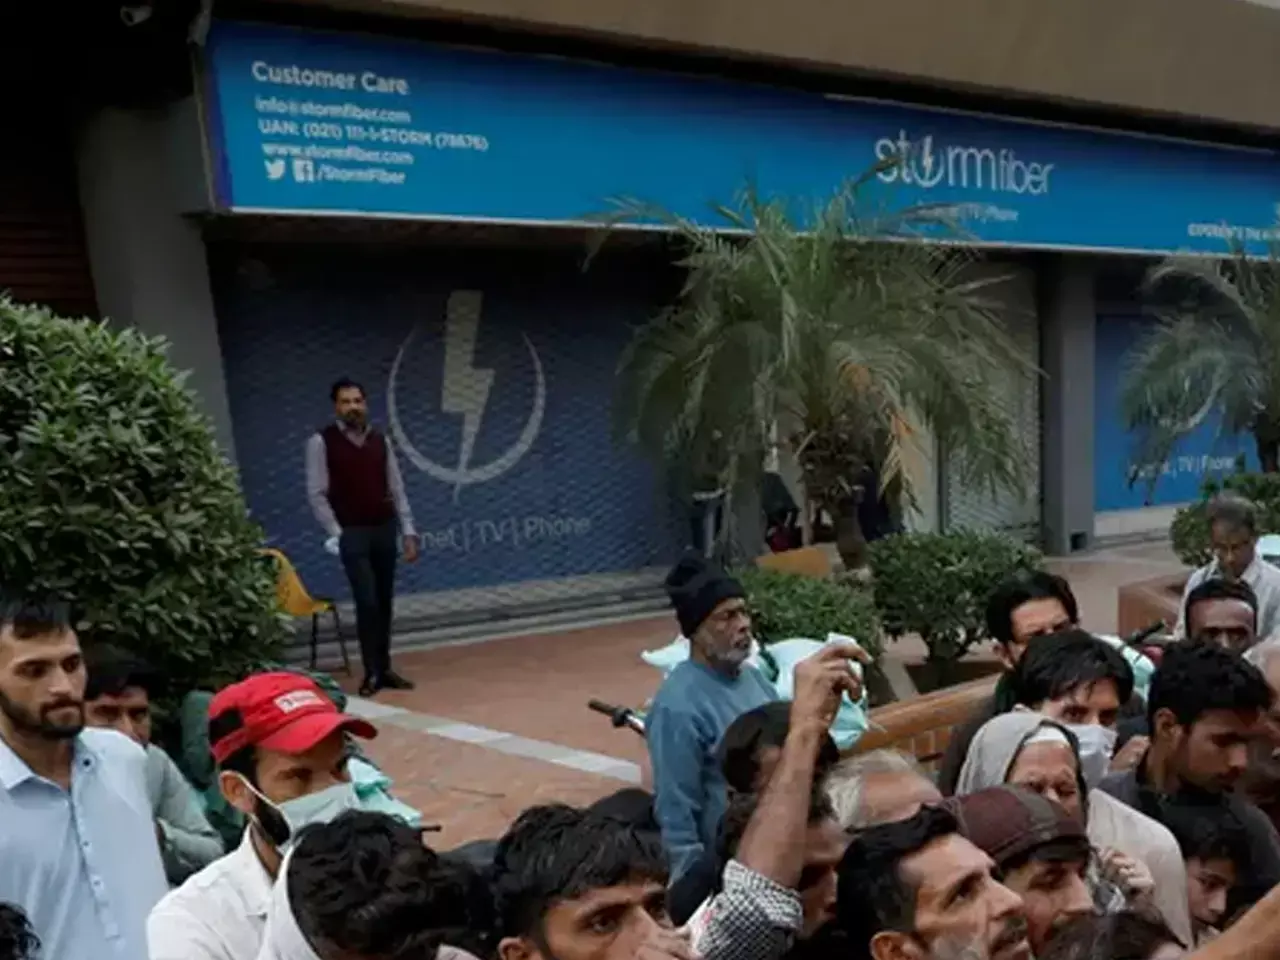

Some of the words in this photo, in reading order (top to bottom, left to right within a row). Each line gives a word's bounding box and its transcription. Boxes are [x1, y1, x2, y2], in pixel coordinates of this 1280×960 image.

[252, 61, 356, 90] Customer
[361, 71, 409, 95] Care
[258, 118, 299, 135] UAN:
[475, 520, 507, 544] TV
[524, 516, 591, 540] Phone
